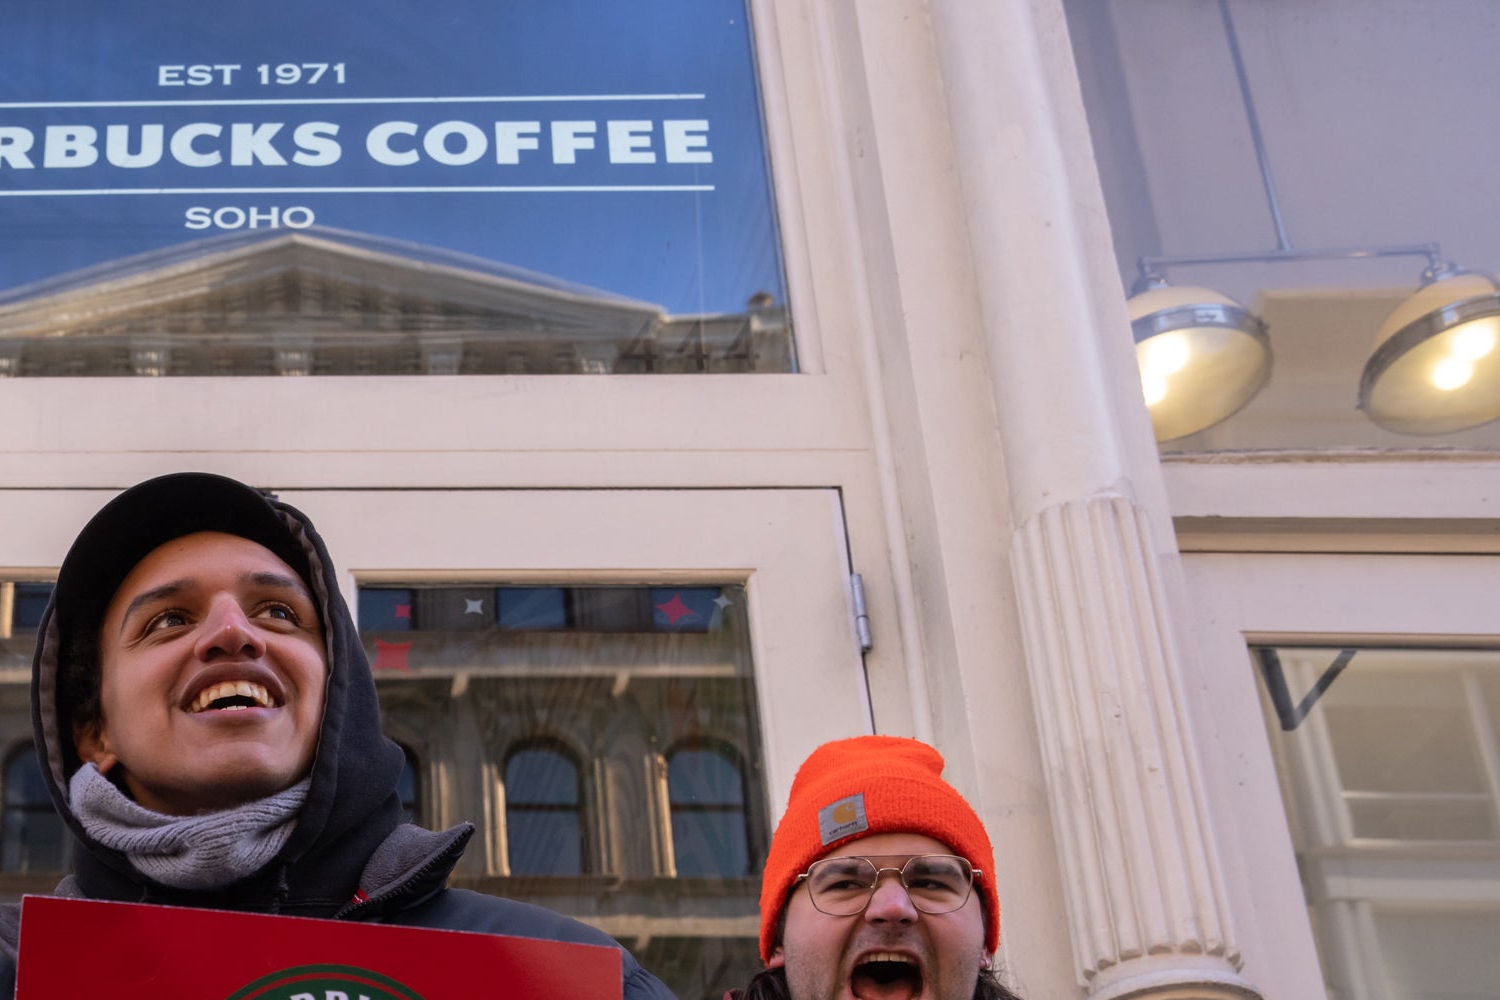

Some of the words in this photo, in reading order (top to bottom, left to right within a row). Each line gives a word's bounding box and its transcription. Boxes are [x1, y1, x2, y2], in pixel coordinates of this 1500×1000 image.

[157, 64, 241, 87] EST
[257, 62, 348, 86] 1971
[366, 118, 713, 168] COFFEE
[184, 206, 315, 231] SOHO
